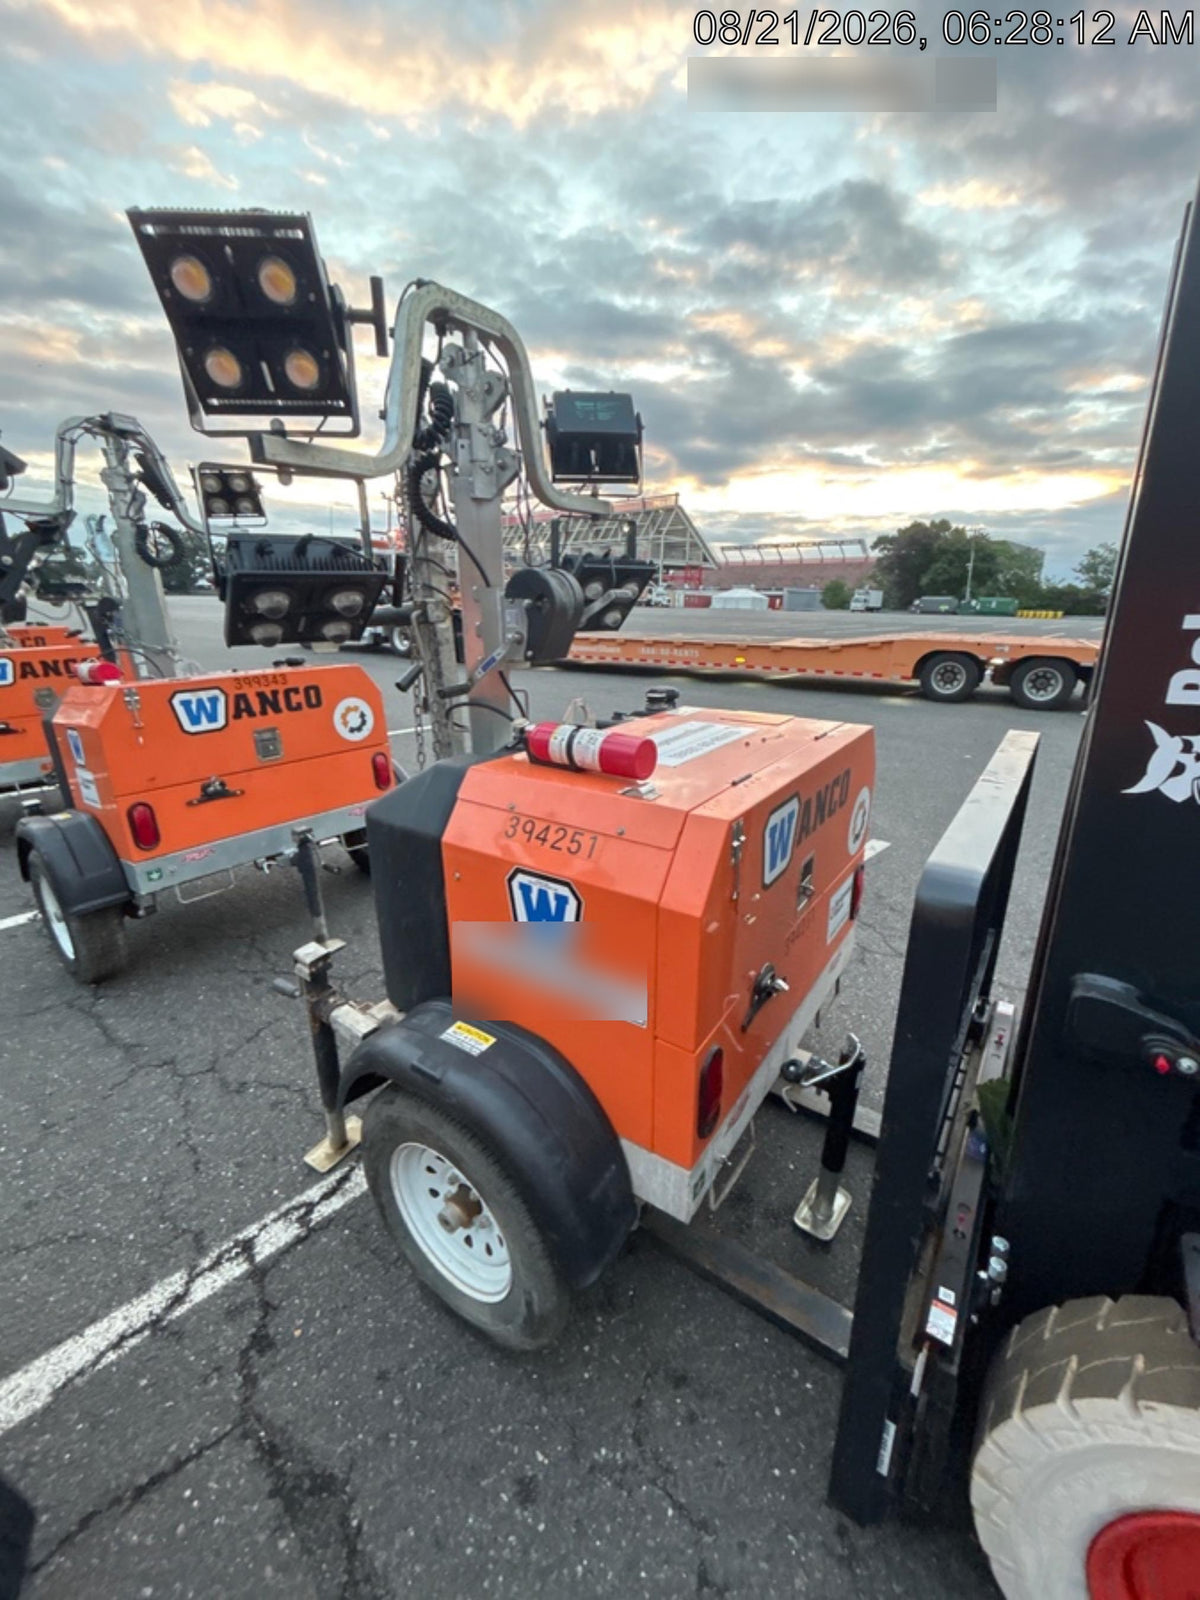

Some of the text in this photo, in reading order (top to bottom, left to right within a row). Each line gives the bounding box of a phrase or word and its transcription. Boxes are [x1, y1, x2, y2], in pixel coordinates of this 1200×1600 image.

[233, 674, 288, 690] 399343
[176, 683, 323, 728] WANCO
[504, 815, 598, 860] 394251
[766, 767, 851, 876] WANCO
